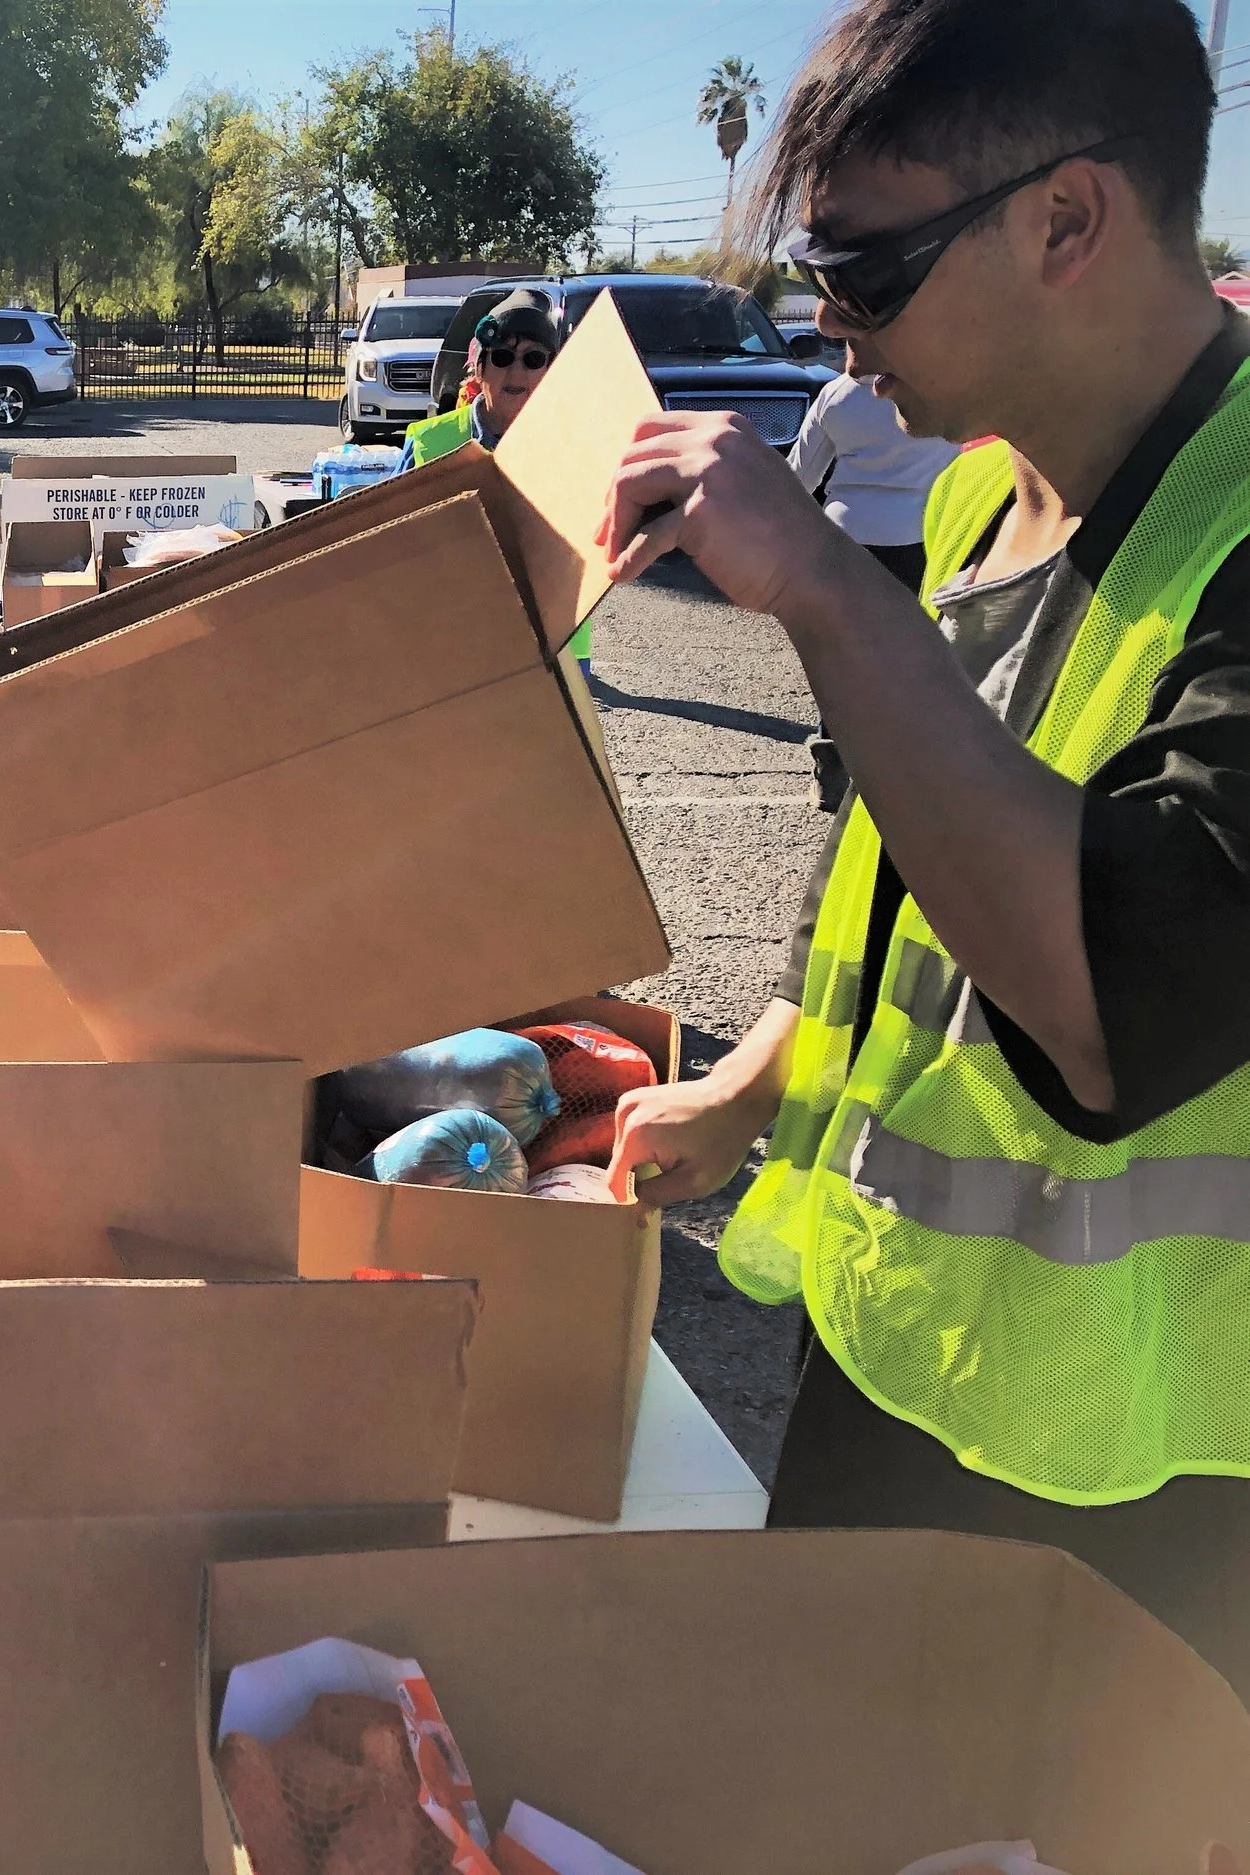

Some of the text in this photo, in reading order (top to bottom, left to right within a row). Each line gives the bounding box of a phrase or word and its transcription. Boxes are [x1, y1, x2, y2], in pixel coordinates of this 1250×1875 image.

[47, 488, 117, 503] PERISHABLE
[129, 488, 158, 502] KEEP
[161, 486, 206, 501] FROZEN
[52, 507, 89, 521] STORE
[91, 506, 106, 521] AT
[108, 506, 122, 520] 0°
[125, 506, 132, 520] F
[136, 506, 151, 520] OR
[154, 504, 199, 519] COLDER
